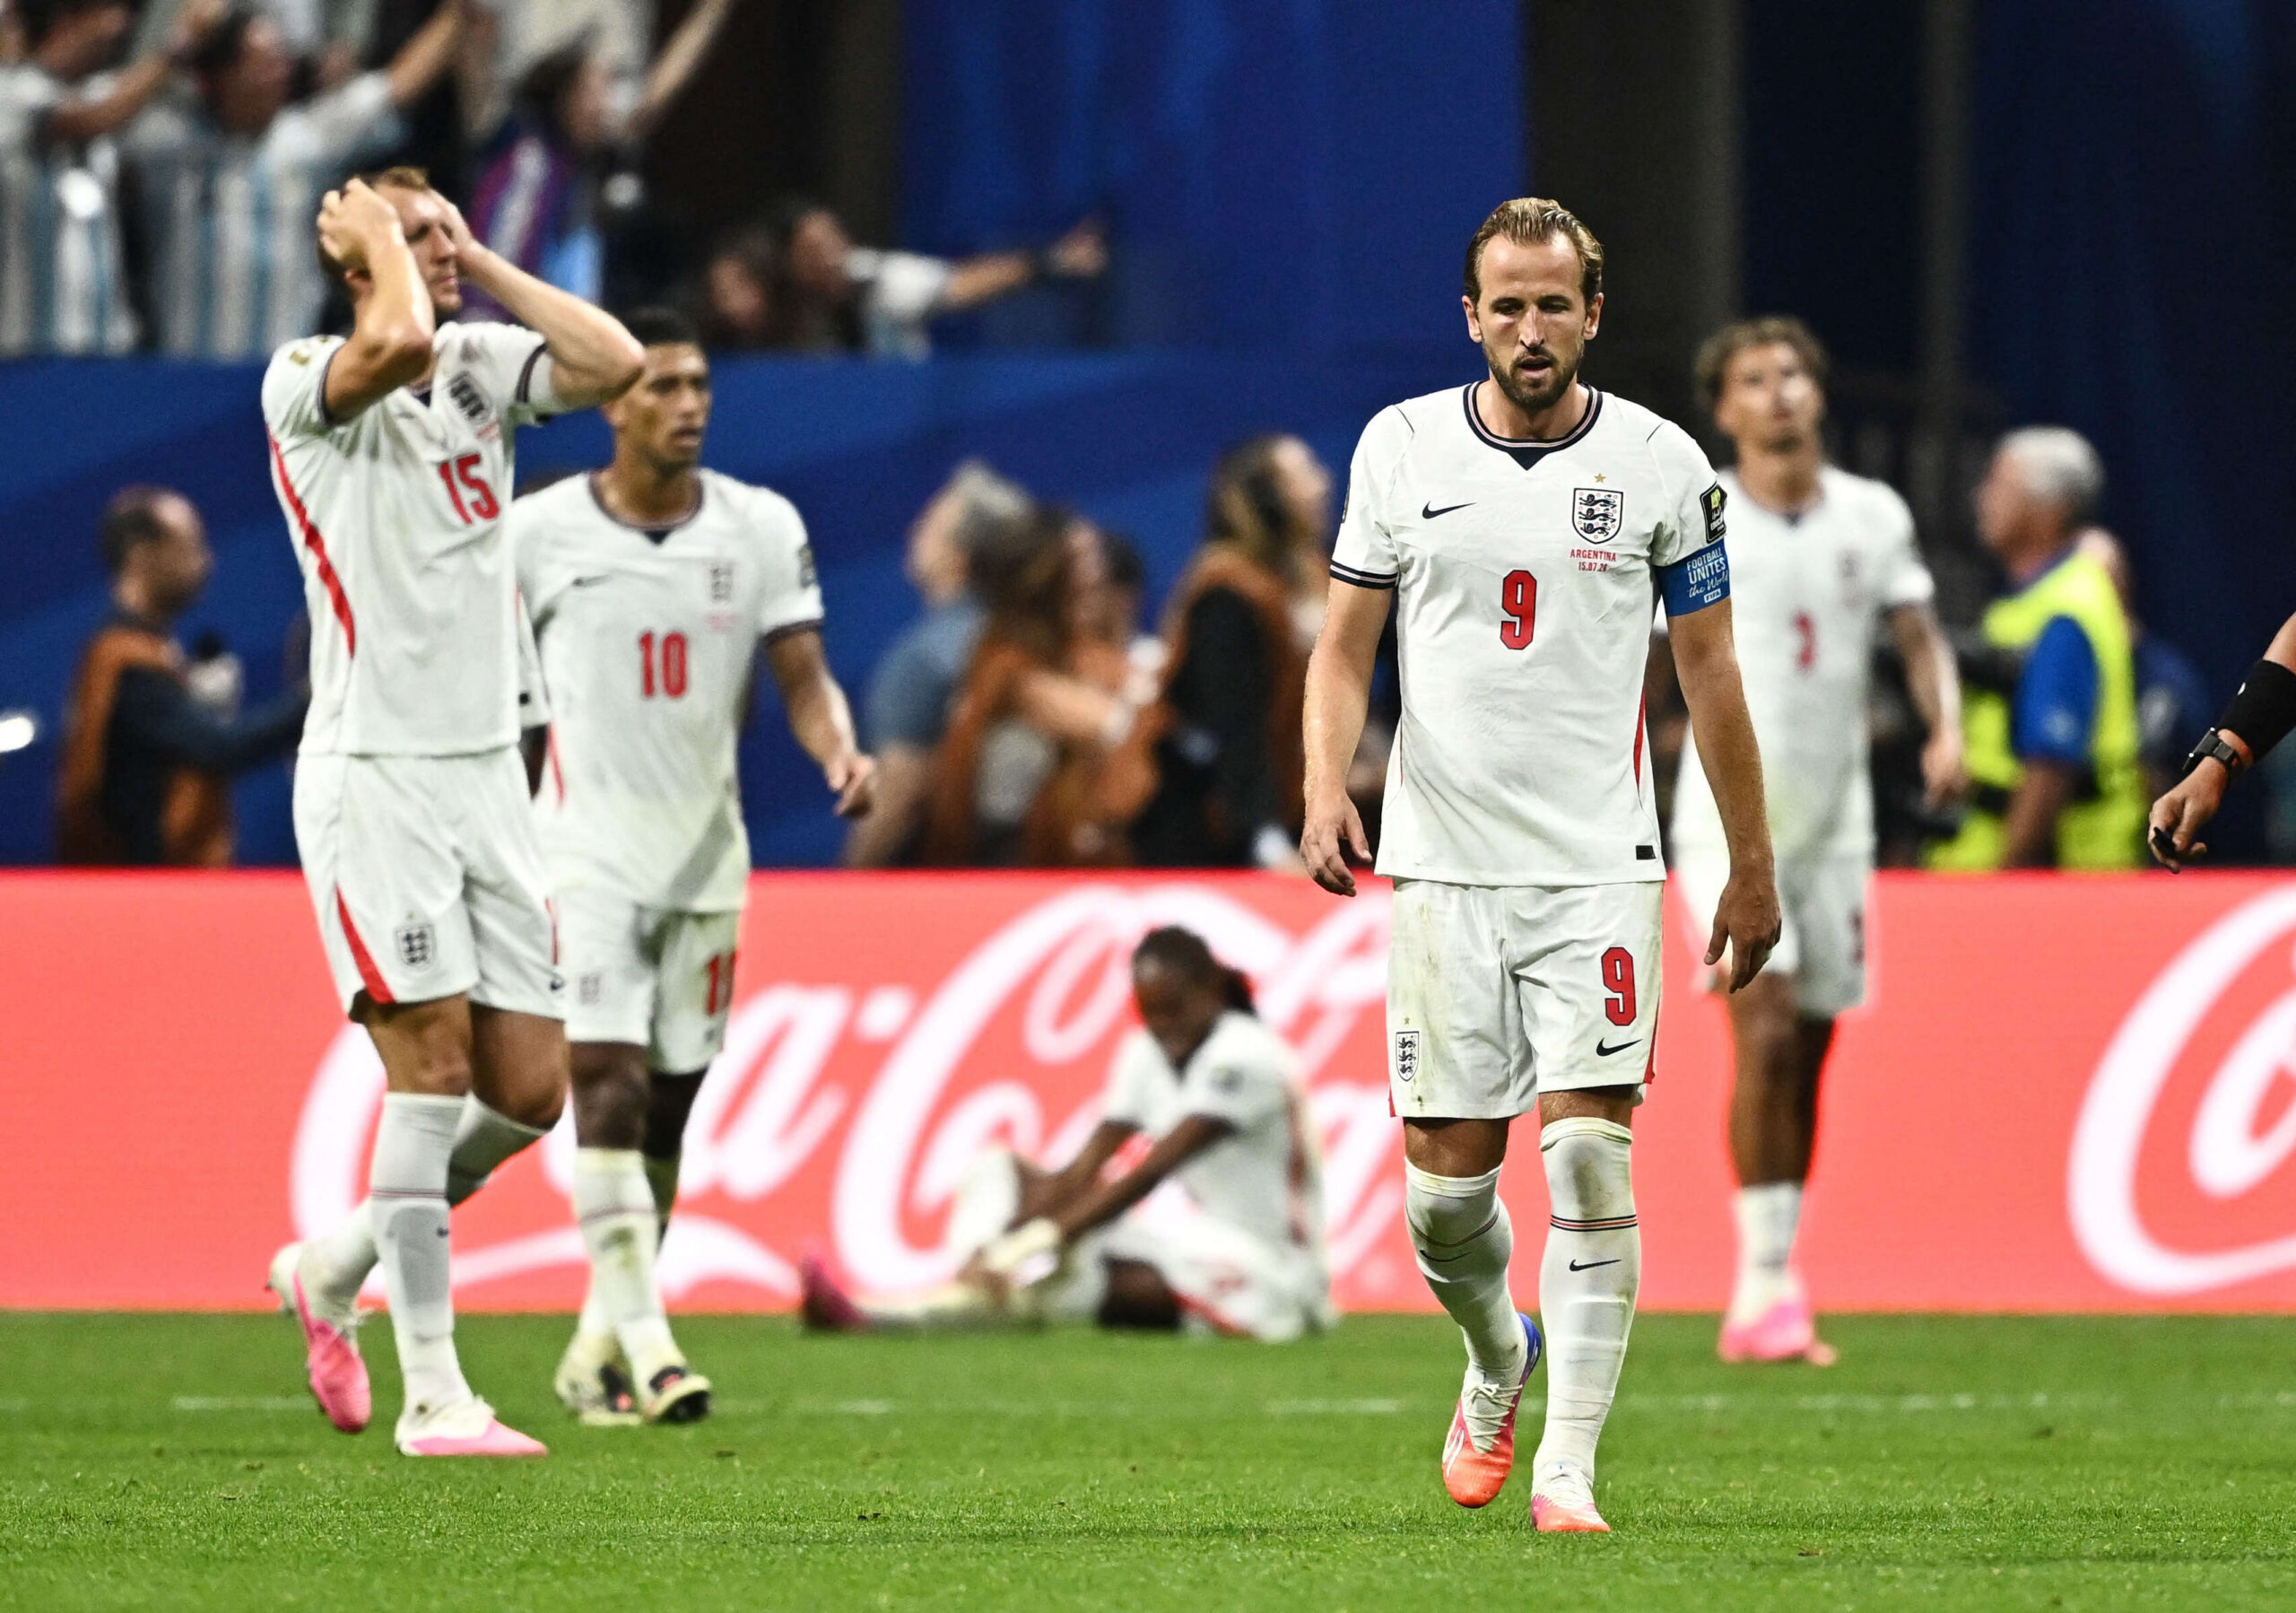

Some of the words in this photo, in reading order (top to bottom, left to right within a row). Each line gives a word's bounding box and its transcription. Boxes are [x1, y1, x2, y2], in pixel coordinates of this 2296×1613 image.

[438, 451, 500, 526] 15
[1570, 548, 1617, 562] ARGENTINA
[1687, 547, 1723, 571] FOOTBALL
[1688, 556, 1726, 584] UNITES
[1689, 585, 1706, 598] the
[1707, 571, 1728, 591] World
[1705, 589, 1721, 602] FIFA
[1500, 570, 1537, 650] 9
[638, 632, 688, 698] 10
[1601, 947, 1637, 1026] 9
